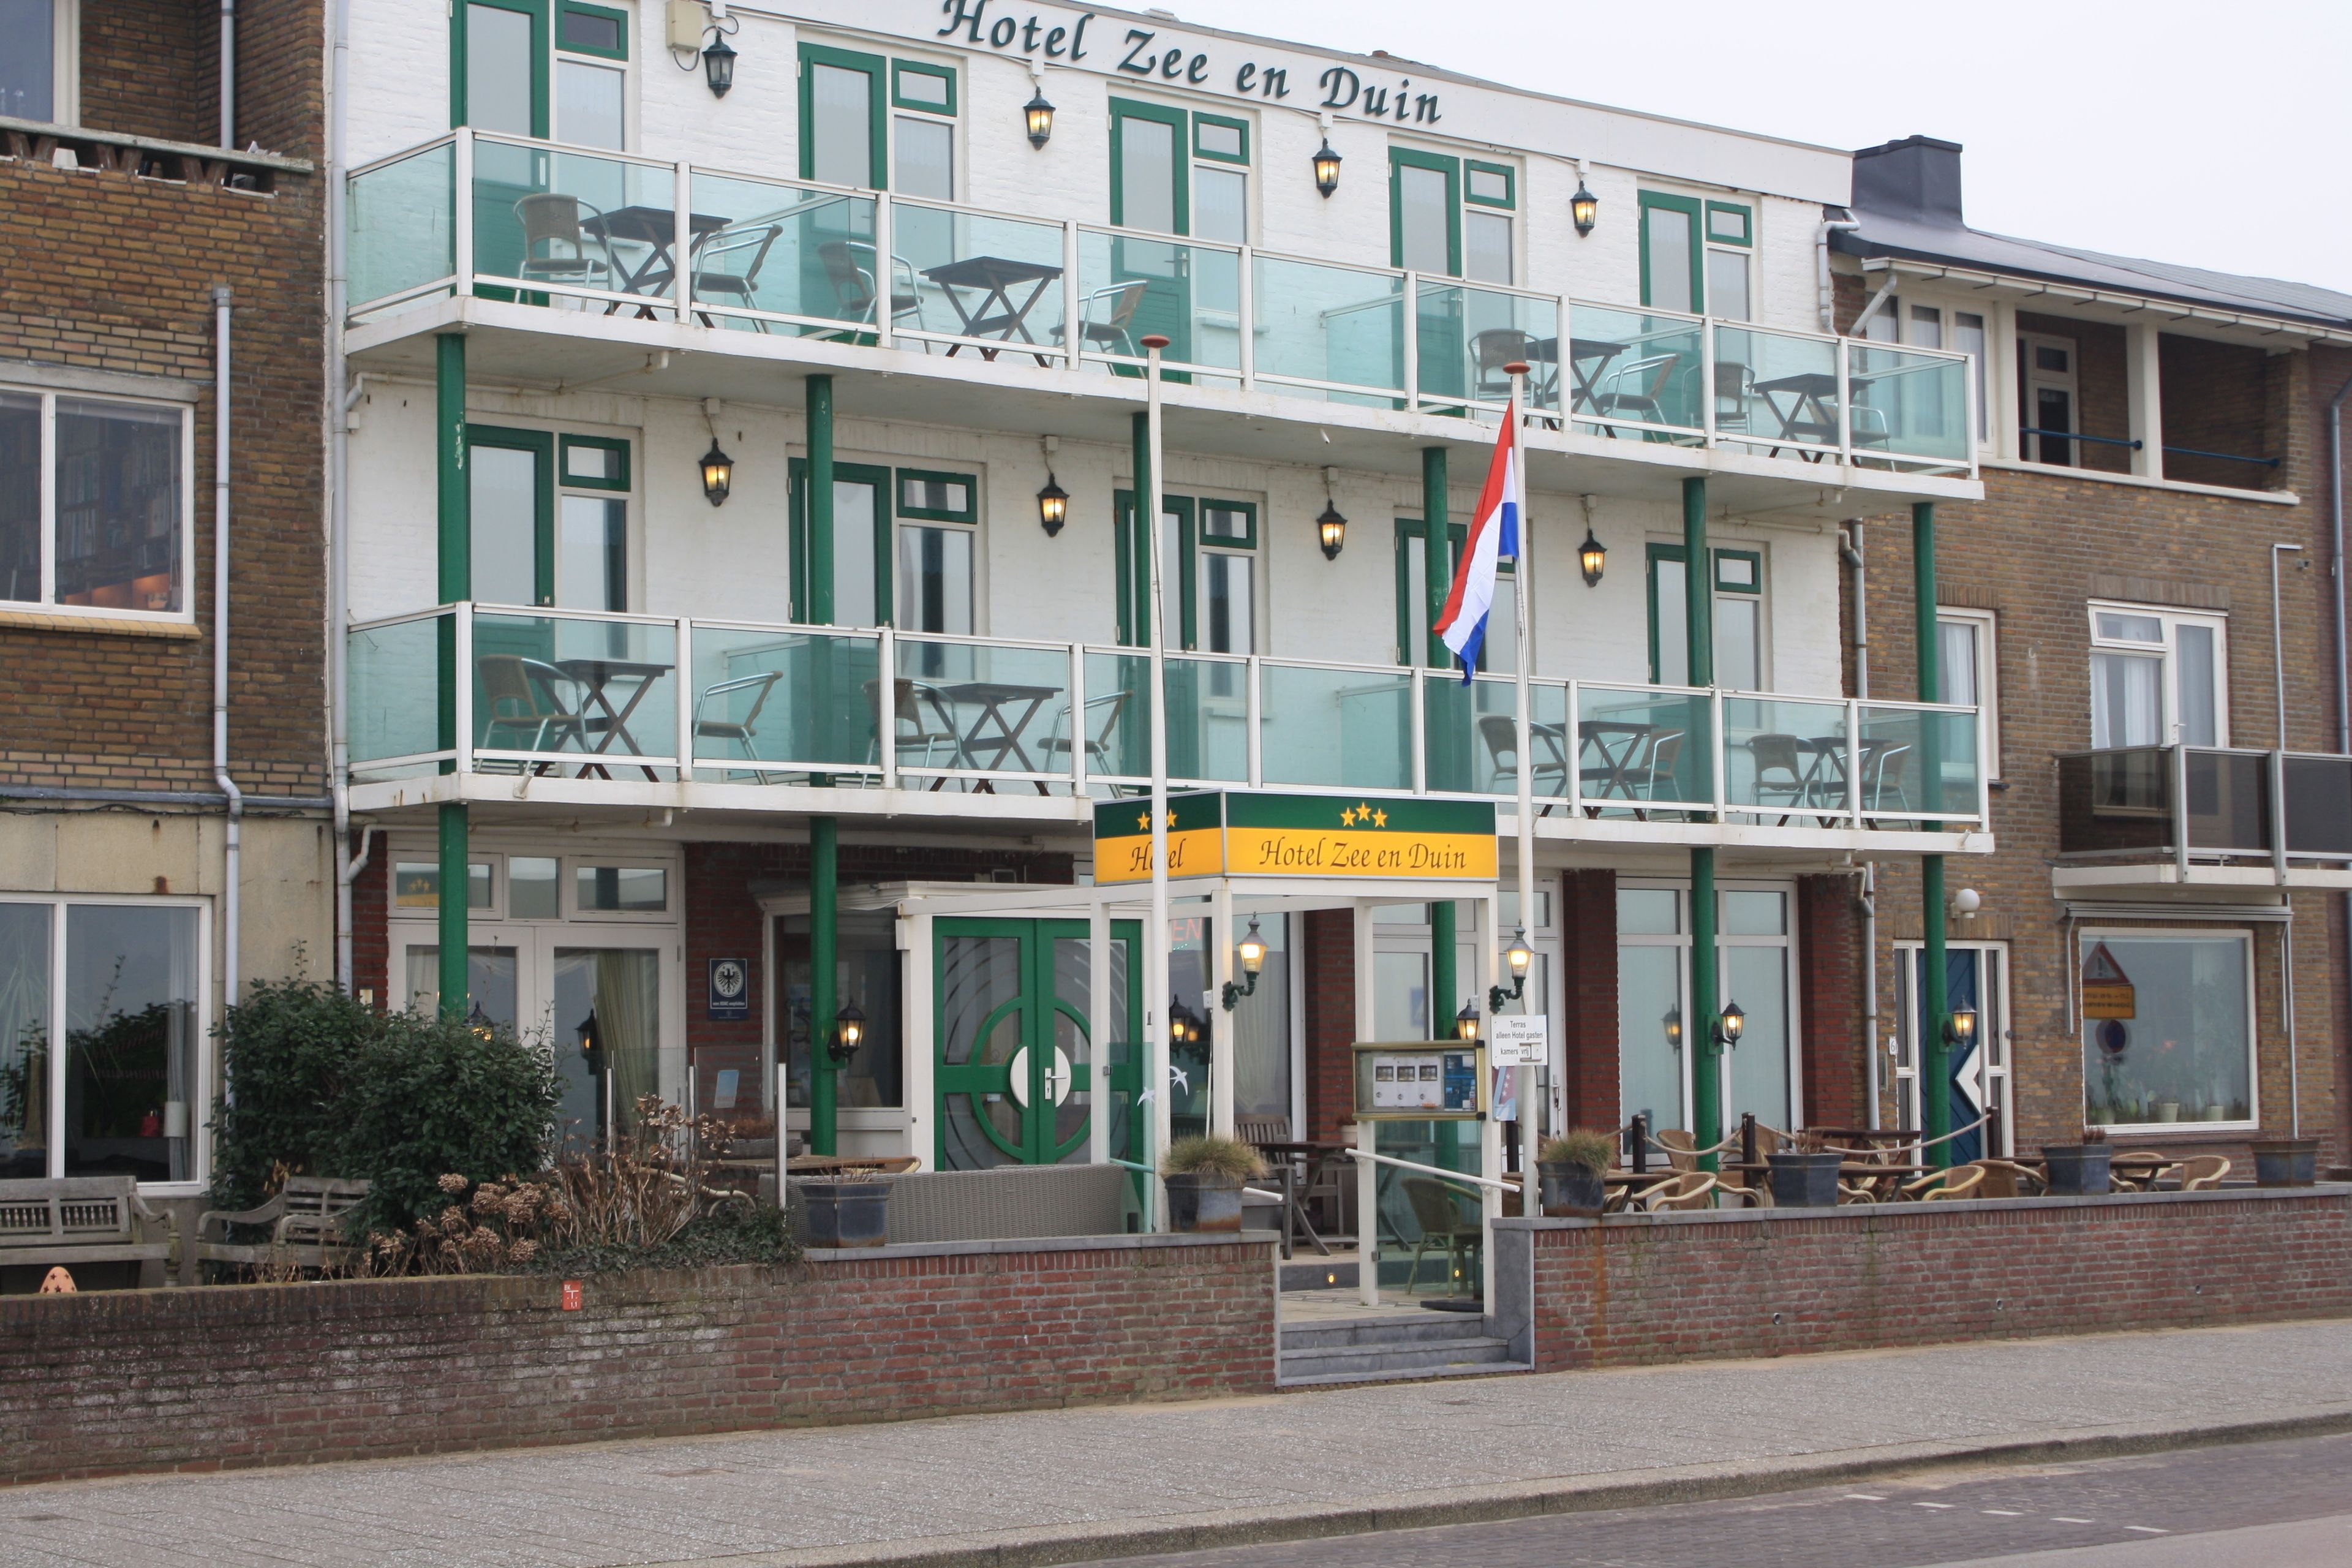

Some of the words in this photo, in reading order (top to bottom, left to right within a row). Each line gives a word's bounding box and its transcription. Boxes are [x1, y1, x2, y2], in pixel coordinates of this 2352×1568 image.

[937, 0, 1095, 61] Hotel
[1117, 29, 1208, 84] Zee
[1237, 62, 1290, 99] en
[1320, 67, 1442, 124] Duin
[1129, 838, 1187, 872] Hel
[1259, 836, 1327, 866] Hotel
[1330, 842, 1371, 868] Zee
[1378, 850, 1402, 868] en
[1409, 843, 1467, 869] Duin
[1520, 1047, 1529, 1057] vrij
